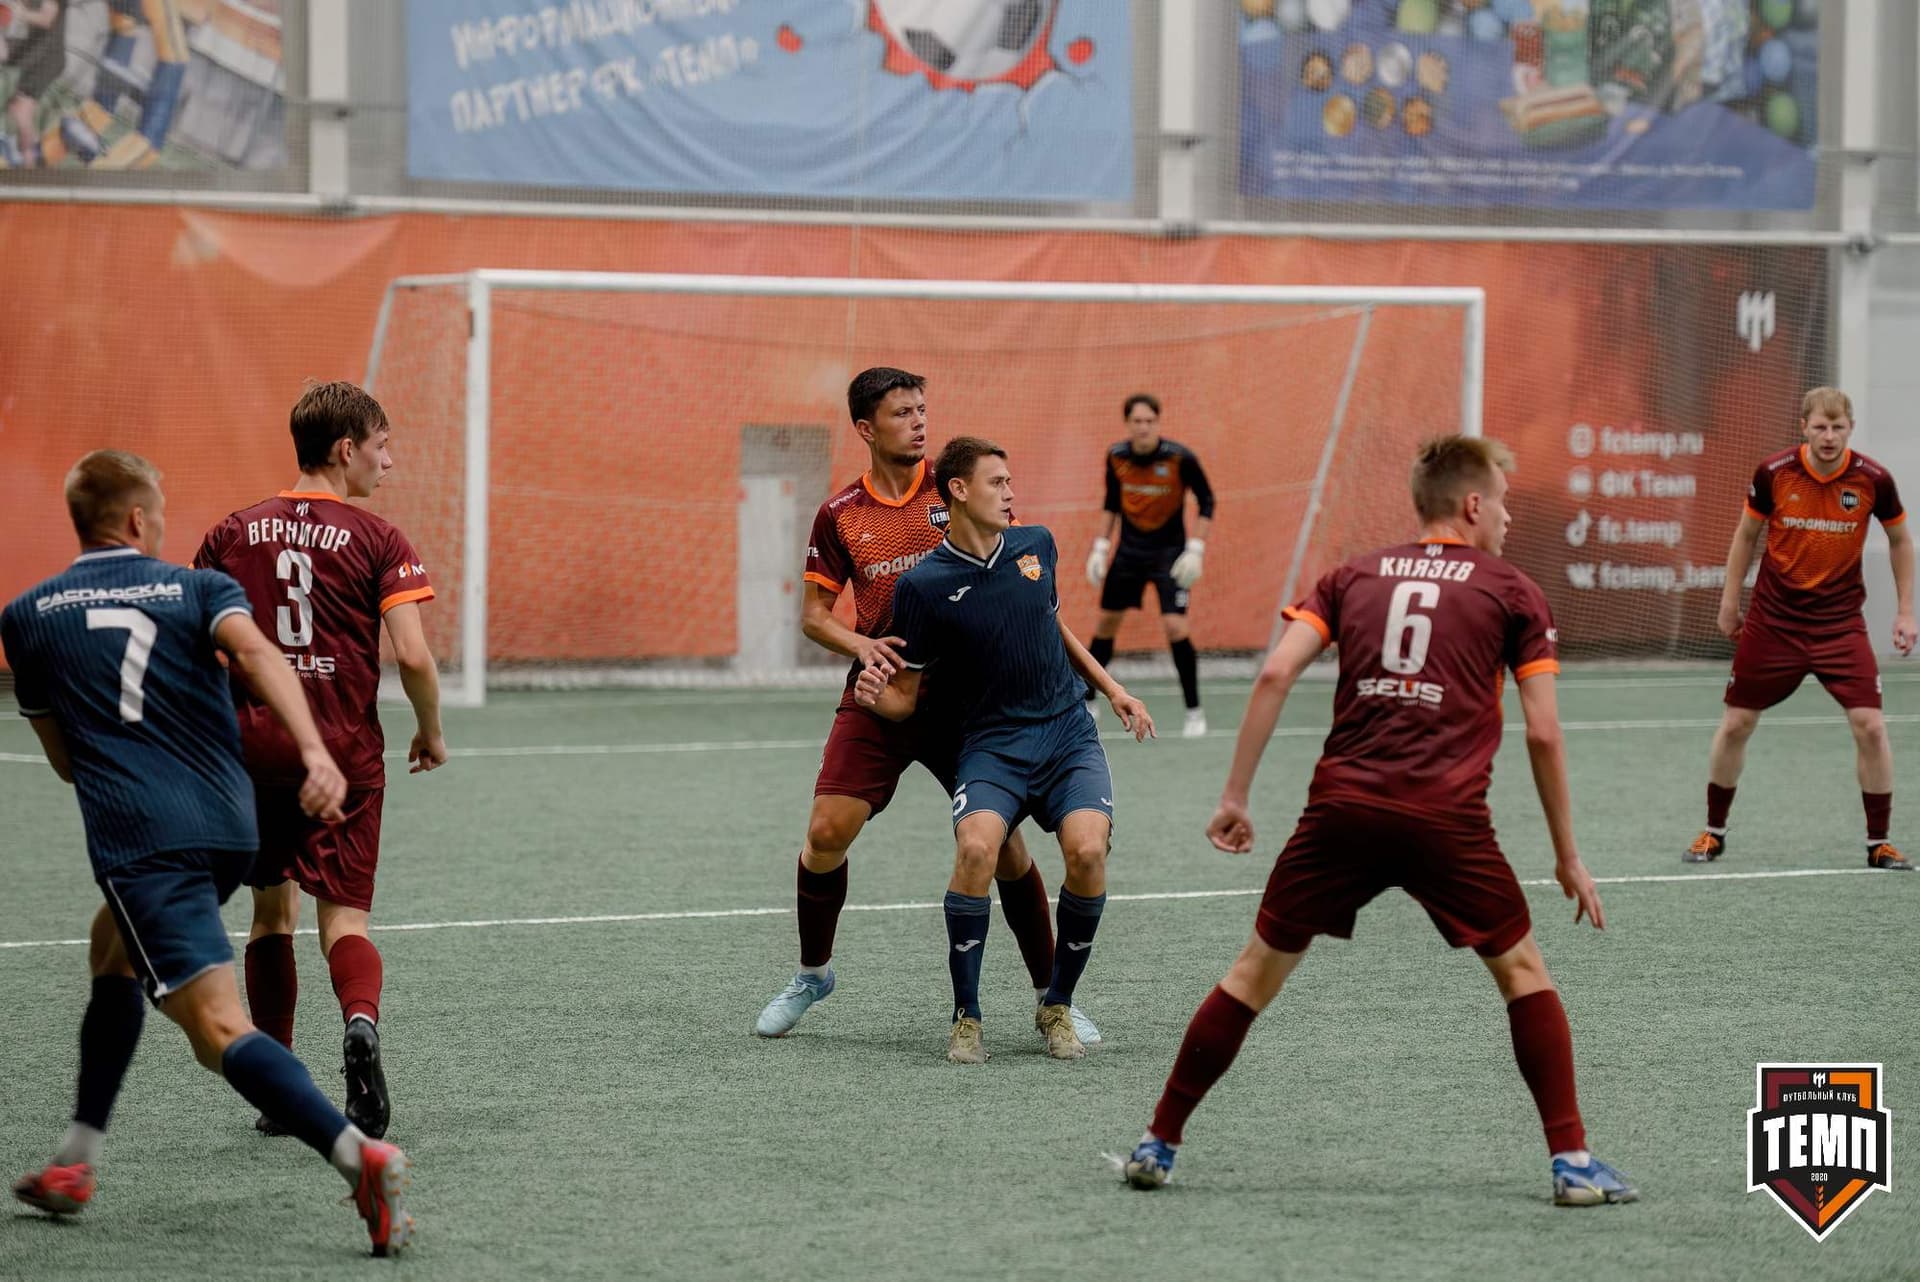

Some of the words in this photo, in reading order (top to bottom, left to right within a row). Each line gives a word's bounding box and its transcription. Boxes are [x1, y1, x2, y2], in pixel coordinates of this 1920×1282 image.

[450, 67, 586, 133] ПАРТНЕР
[591, 56, 643, 99] ФК
[1600, 426, 1704, 459] fctemp.ru
[1599, 470, 1637, 498] ФК
[1640, 470, 1696, 498] Темп
[248, 518, 351, 552] ВЕРНИГОР
[1597, 515, 1683, 547] fc.temp
[1783, 516, 1858, 533] ПРОДИНВЕСТ
[1379, 557, 1476, 582] КНЯЗЕВ
[276, 549, 313, 647] 3
[1381, 581, 1440, 675] 6
[86, 607, 157, 723] 7
[284, 653, 336, 674] EUS
[1356, 678, 1445, 704] SEUS
